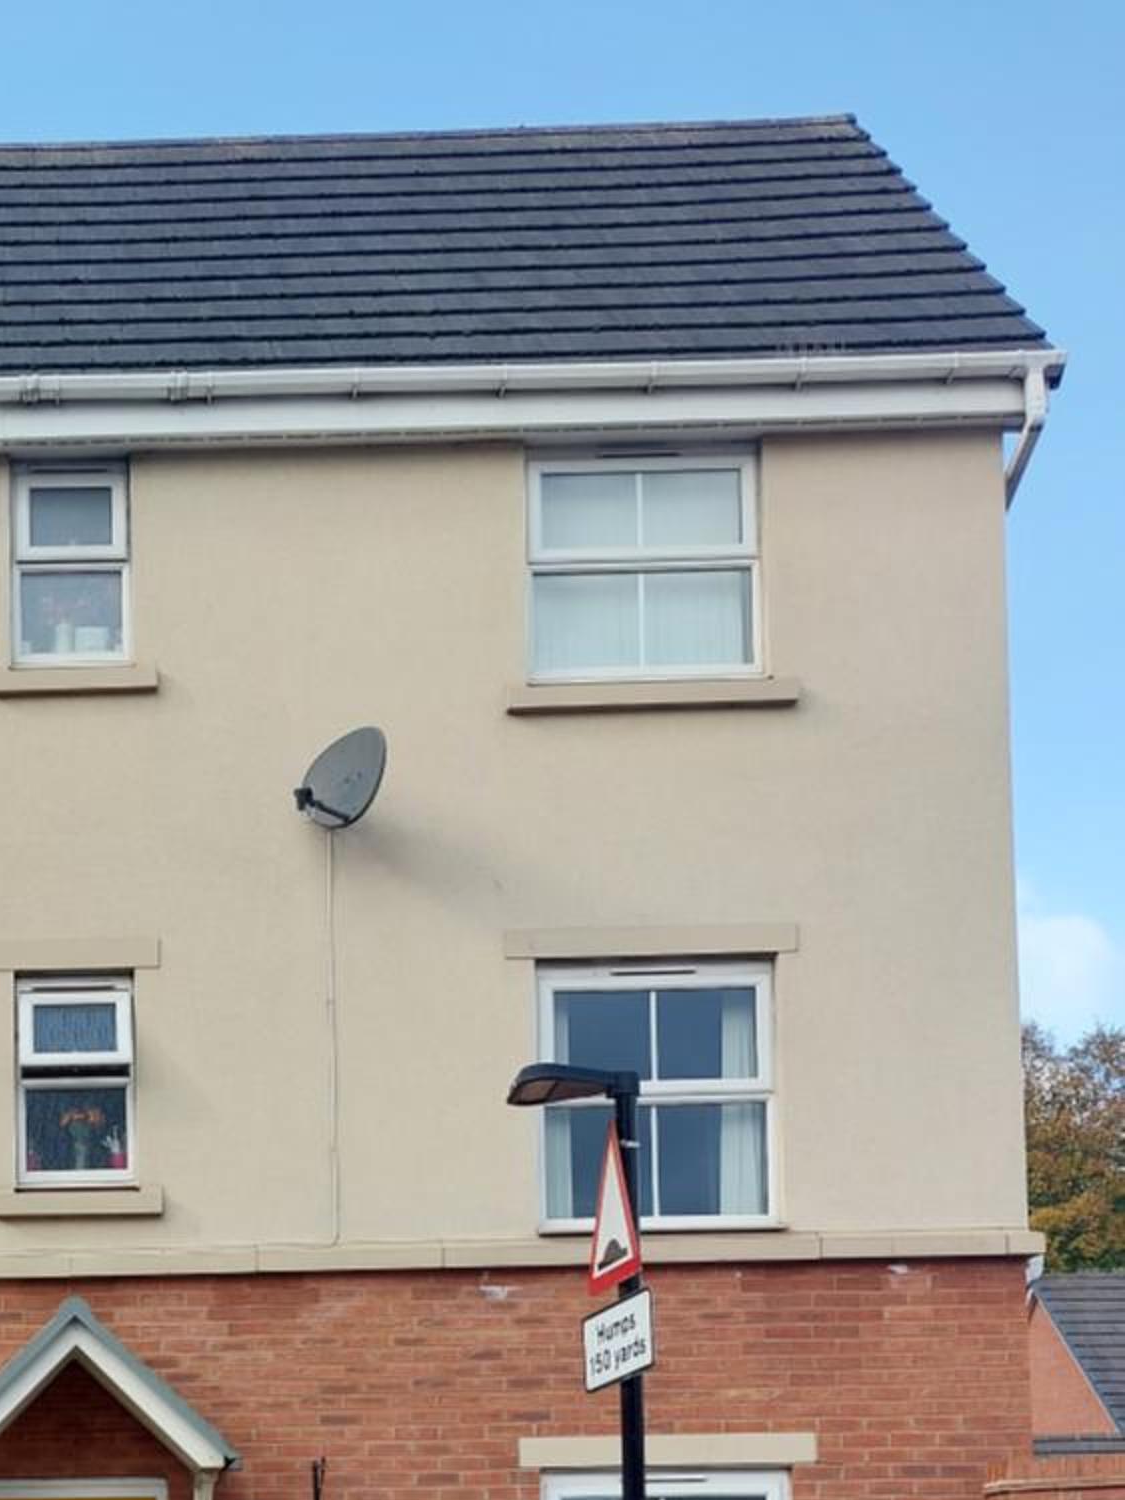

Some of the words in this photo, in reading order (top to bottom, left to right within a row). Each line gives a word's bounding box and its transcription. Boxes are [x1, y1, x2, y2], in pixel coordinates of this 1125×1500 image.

[595, 1313, 636, 1344] Humps
[590, 1349, 612, 1376] 150
[615, 1335, 646, 1371] yards
